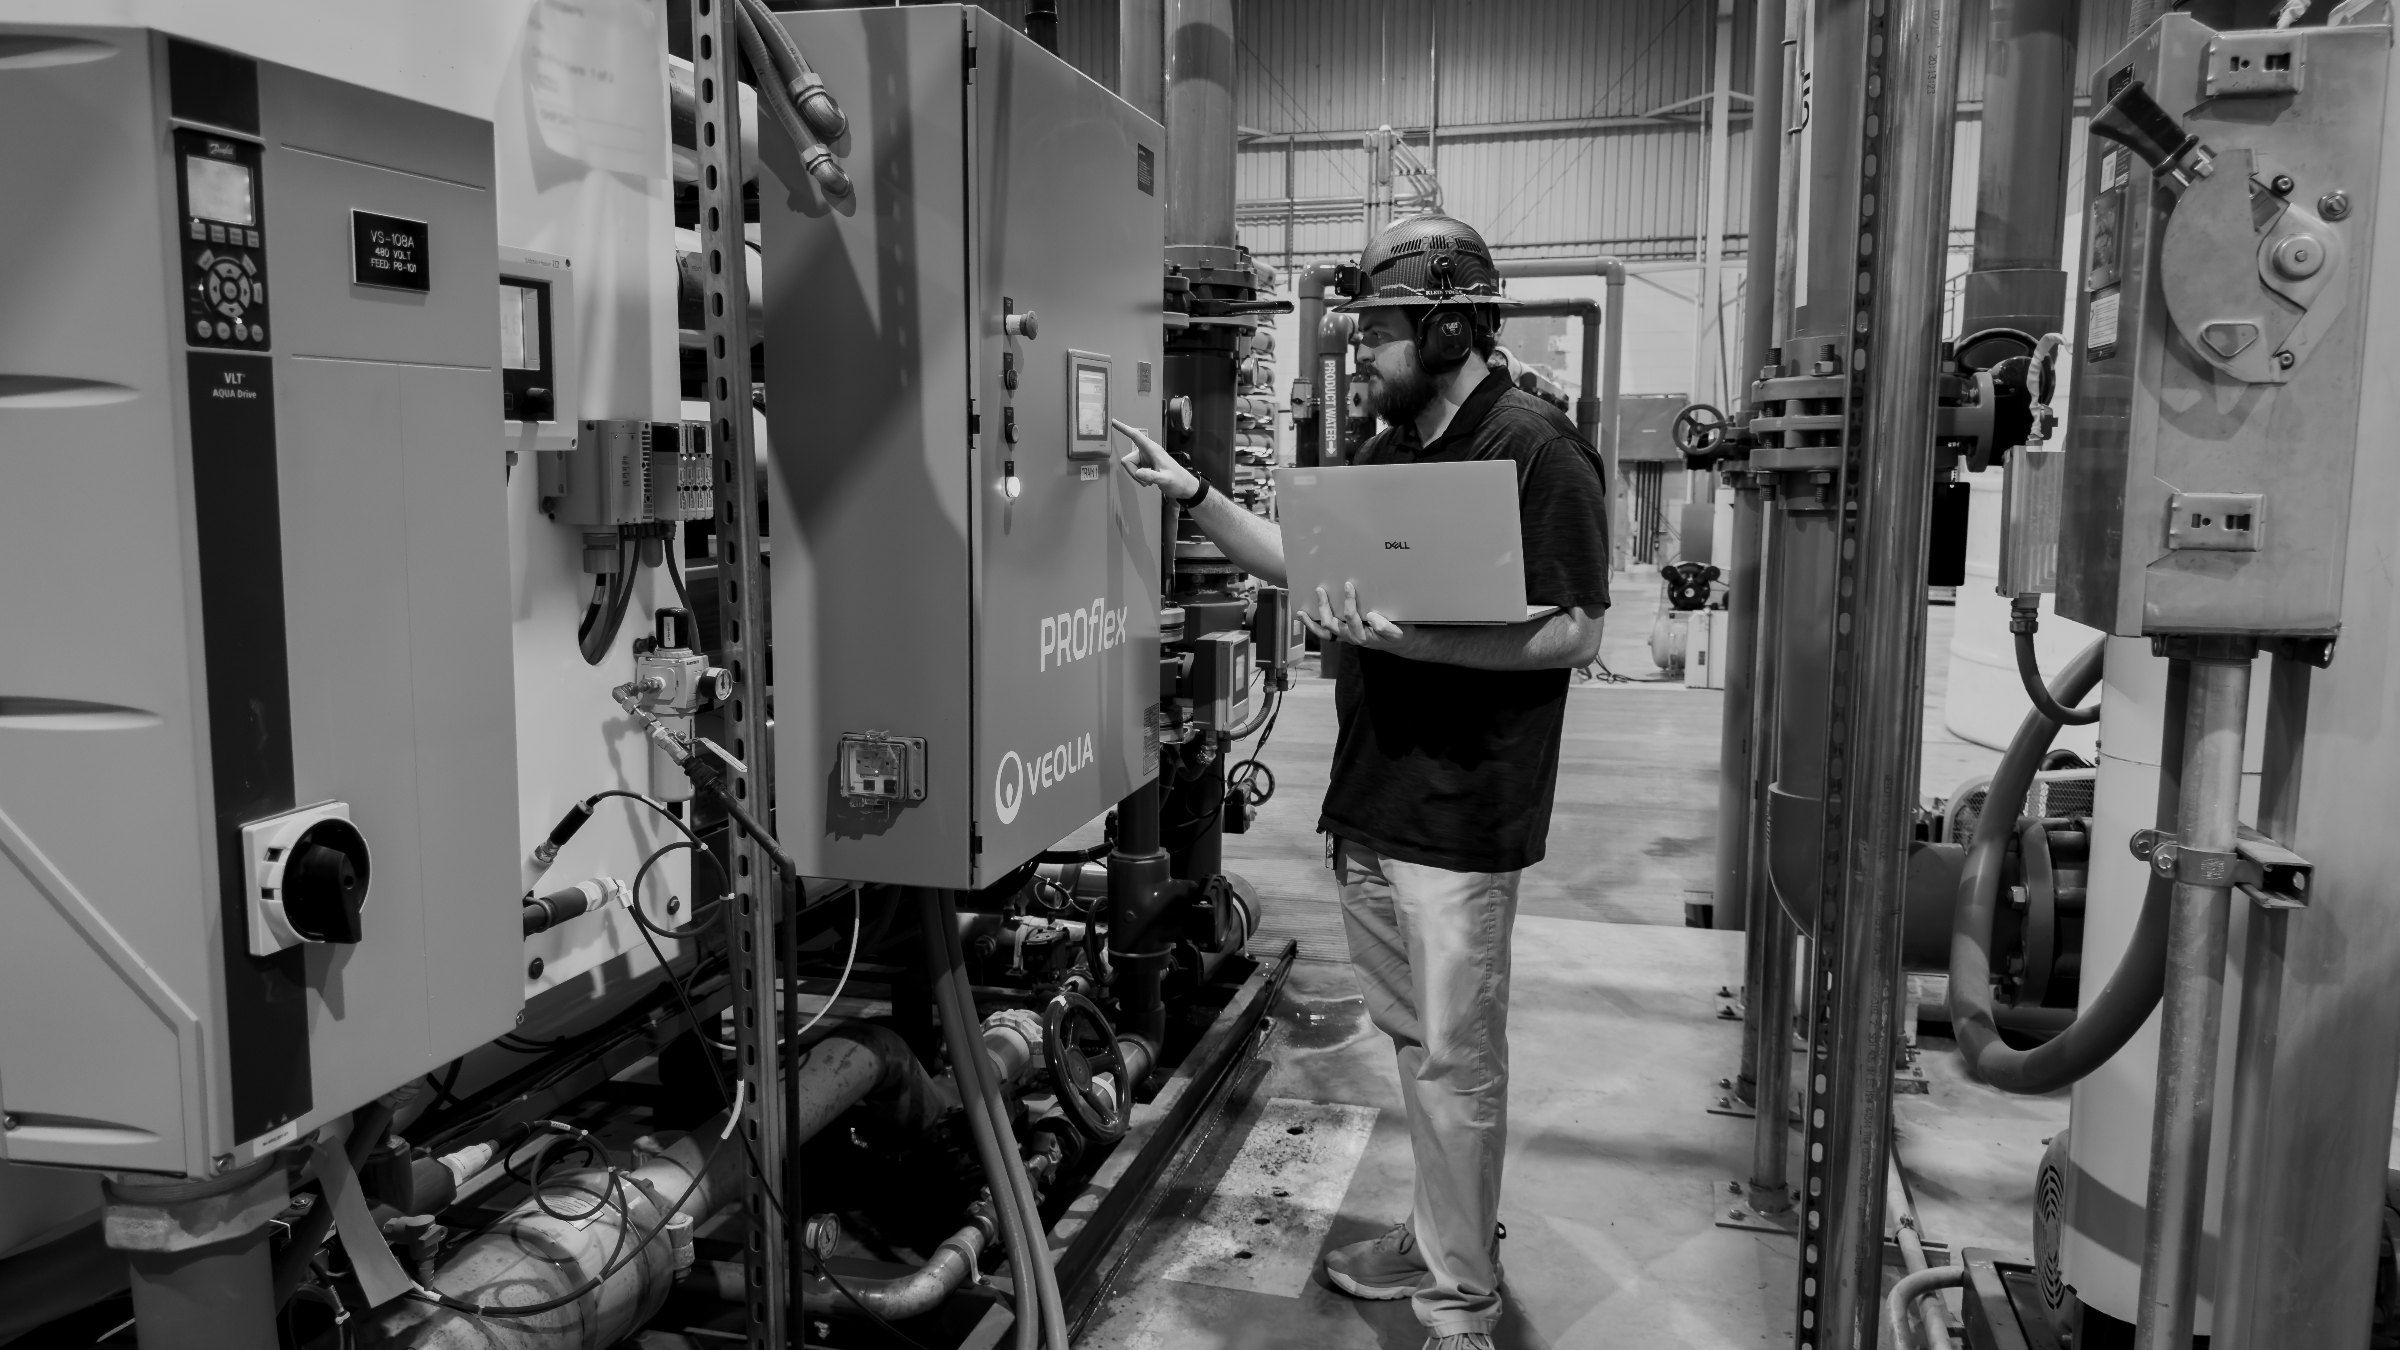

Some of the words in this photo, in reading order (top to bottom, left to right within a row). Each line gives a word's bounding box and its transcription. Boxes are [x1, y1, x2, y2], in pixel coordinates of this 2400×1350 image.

[370, 229, 415, 248] VS-108A
[375, 247, 390, 258] 480
[393, 250, 412, 261] VOLT
[370, 258, 391, 270] FEED:
[1324, 360, 1337, 405] PRODUCT
[212, 388, 236, 398] AQUA
[237, 389, 257, 399] Drive
[1325, 408, 1337, 441] WATER
[1384, 541, 1411, 550] DELL
[1040, 597, 1128, 673] PROflex
[1026, 731, 1094, 796] VEOLIA
